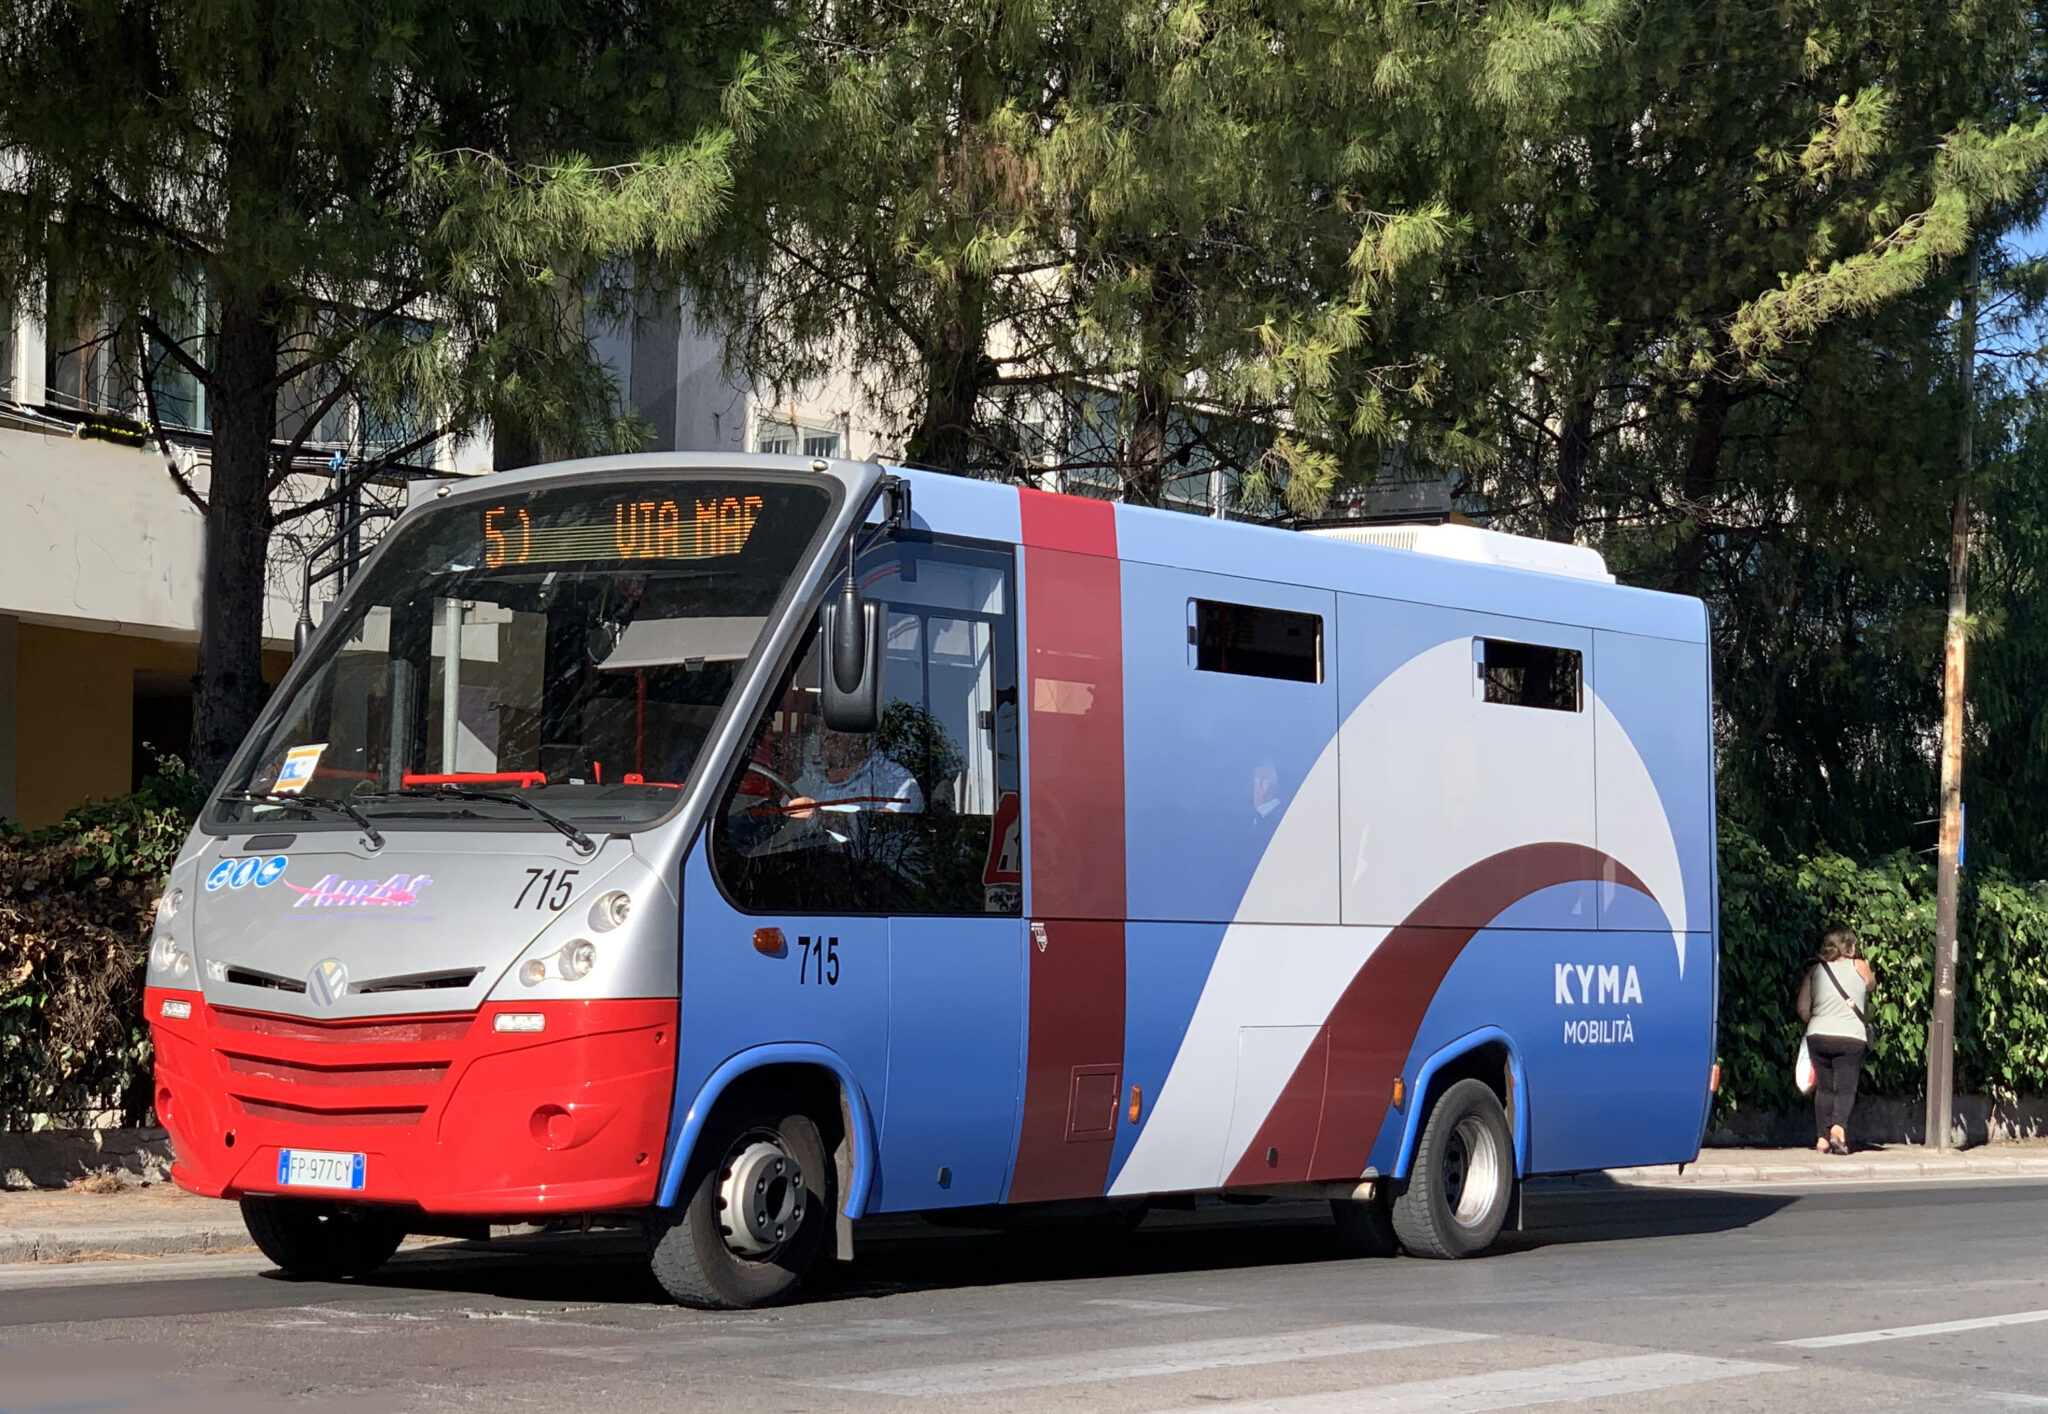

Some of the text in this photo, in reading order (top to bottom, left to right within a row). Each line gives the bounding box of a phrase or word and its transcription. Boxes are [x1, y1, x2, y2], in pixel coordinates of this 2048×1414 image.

[616, 501, 679, 558] VIA
[513, 868, 580, 911] 715
[798, 935, 840, 986] 715
[1555, 962, 1643, 1004] KYMA
[1564, 1013, 1634, 1044] MOBILITÀ
